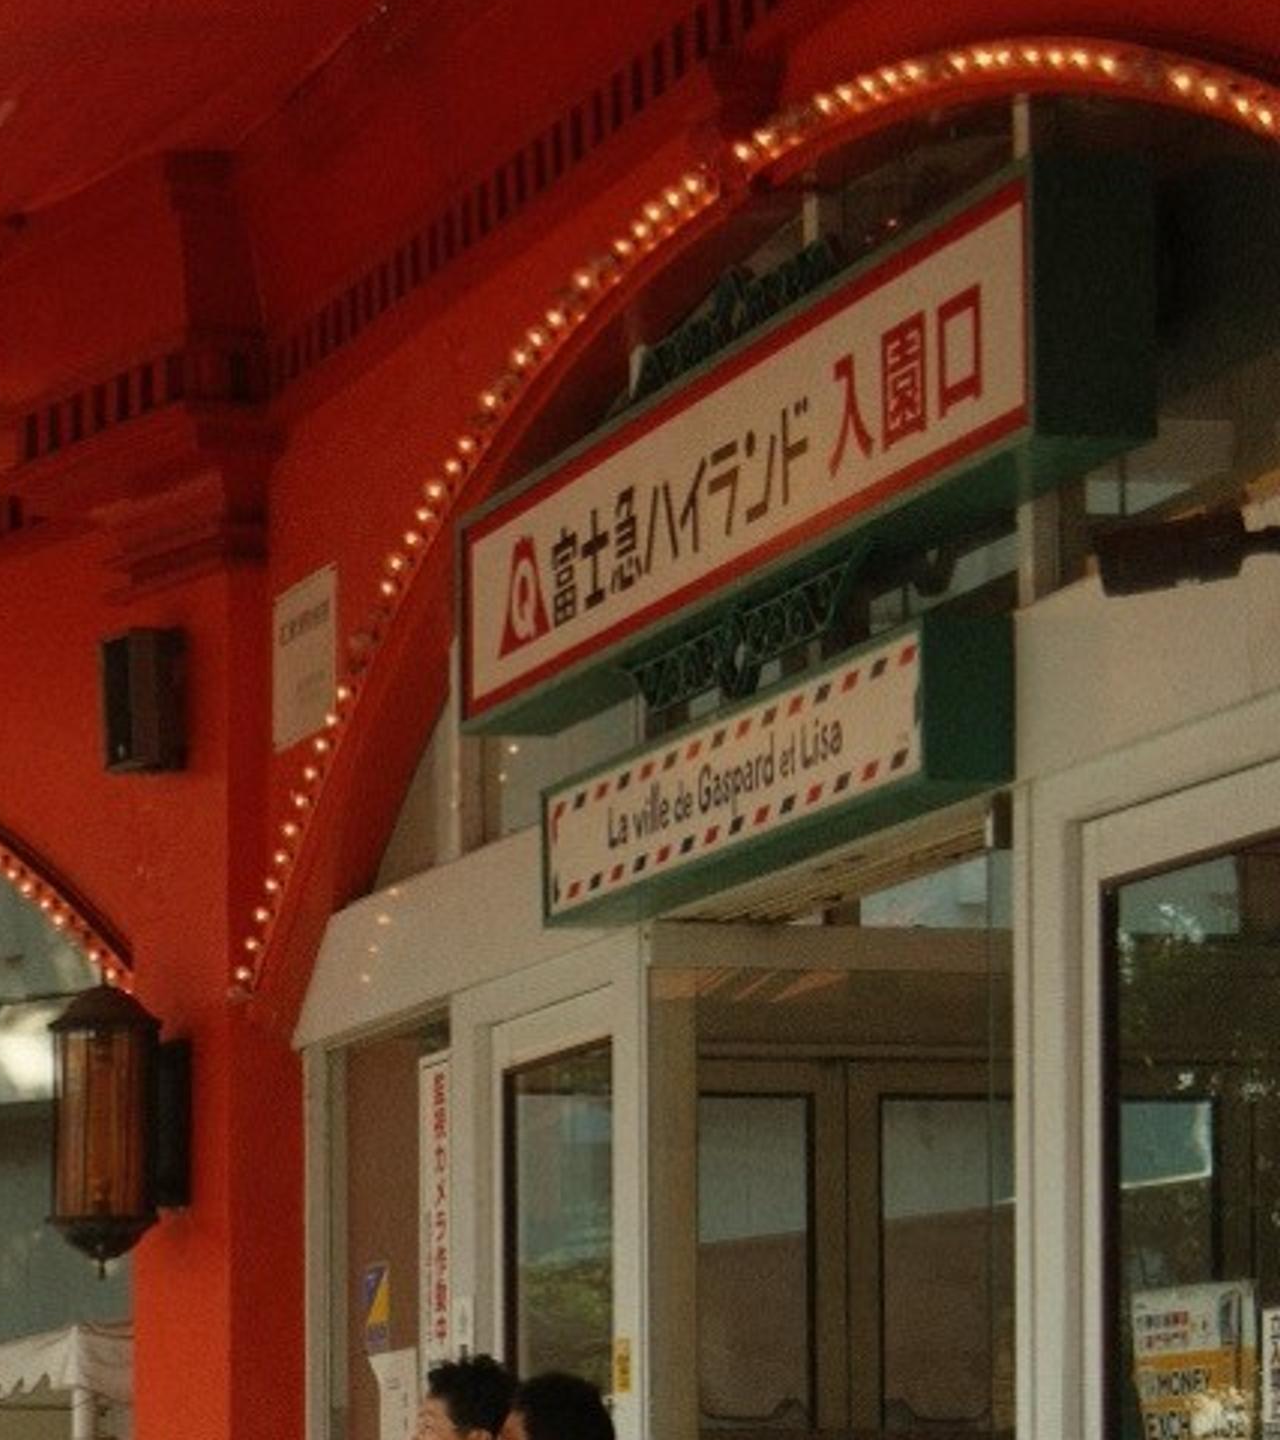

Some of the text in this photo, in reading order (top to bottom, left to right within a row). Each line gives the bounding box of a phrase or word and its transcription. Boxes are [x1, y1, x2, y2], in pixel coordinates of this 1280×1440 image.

[552, 283, 981, 628] 富士急ハイランド 入園口
[607, 718, 843, 849] La ville de Gaspard et Lisa
